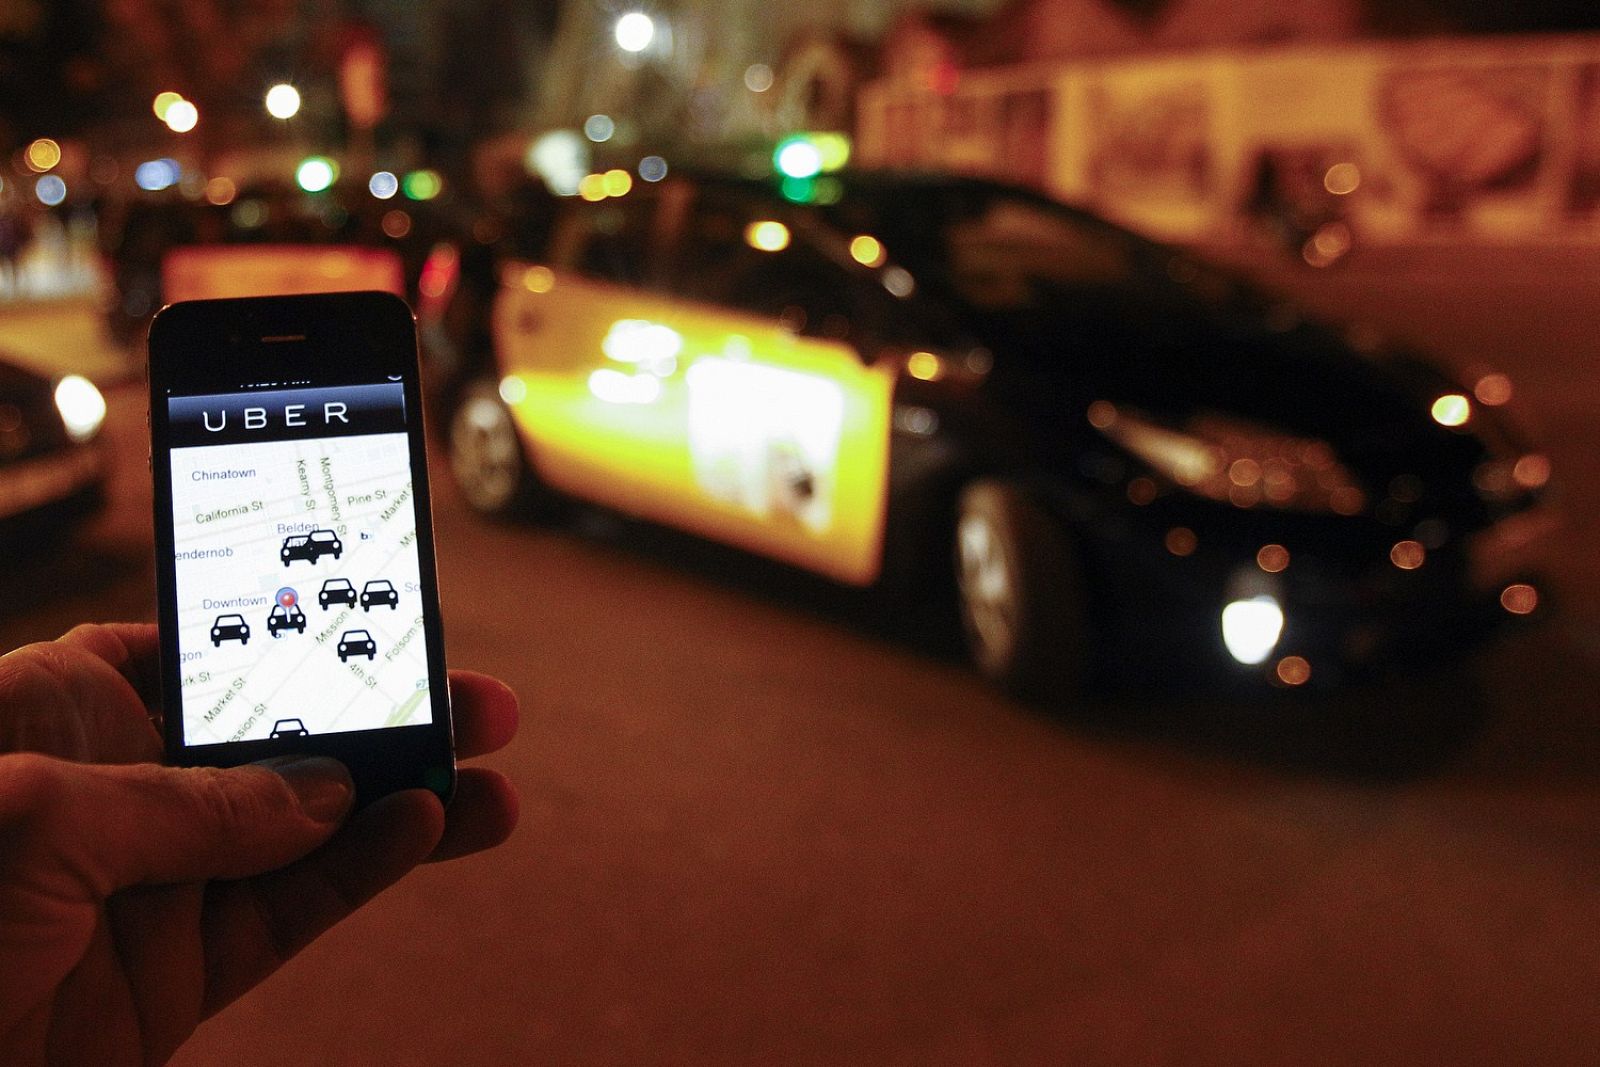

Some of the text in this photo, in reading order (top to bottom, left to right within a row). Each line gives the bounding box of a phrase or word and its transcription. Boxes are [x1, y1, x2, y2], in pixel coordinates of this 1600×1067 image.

[202, 402, 349, 432] UBER
[191, 468, 257, 482] Chinatown
[297, 459, 317, 512] Kearny St
[320, 457, 342, 522] Montgomery
[347, 489, 388, 506] Pine St
[195, 500, 264, 524] California St
[380, 489, 412, 522] Market
[277, 522, 320, 534] Belden
[174, 547, 234, 561] endernob
[202, 597, 268, 610] Downtown
[315, 611, 349, 645] Mission
[384, 627, 417, 662] Folsom
[179, 650, 203, 664] gon
[198, 671, 211, 683] St
[349, 663, 377, 690] 4th St
[203, 677, 247, 723] Market St
[254, 703, 268, 716] St
